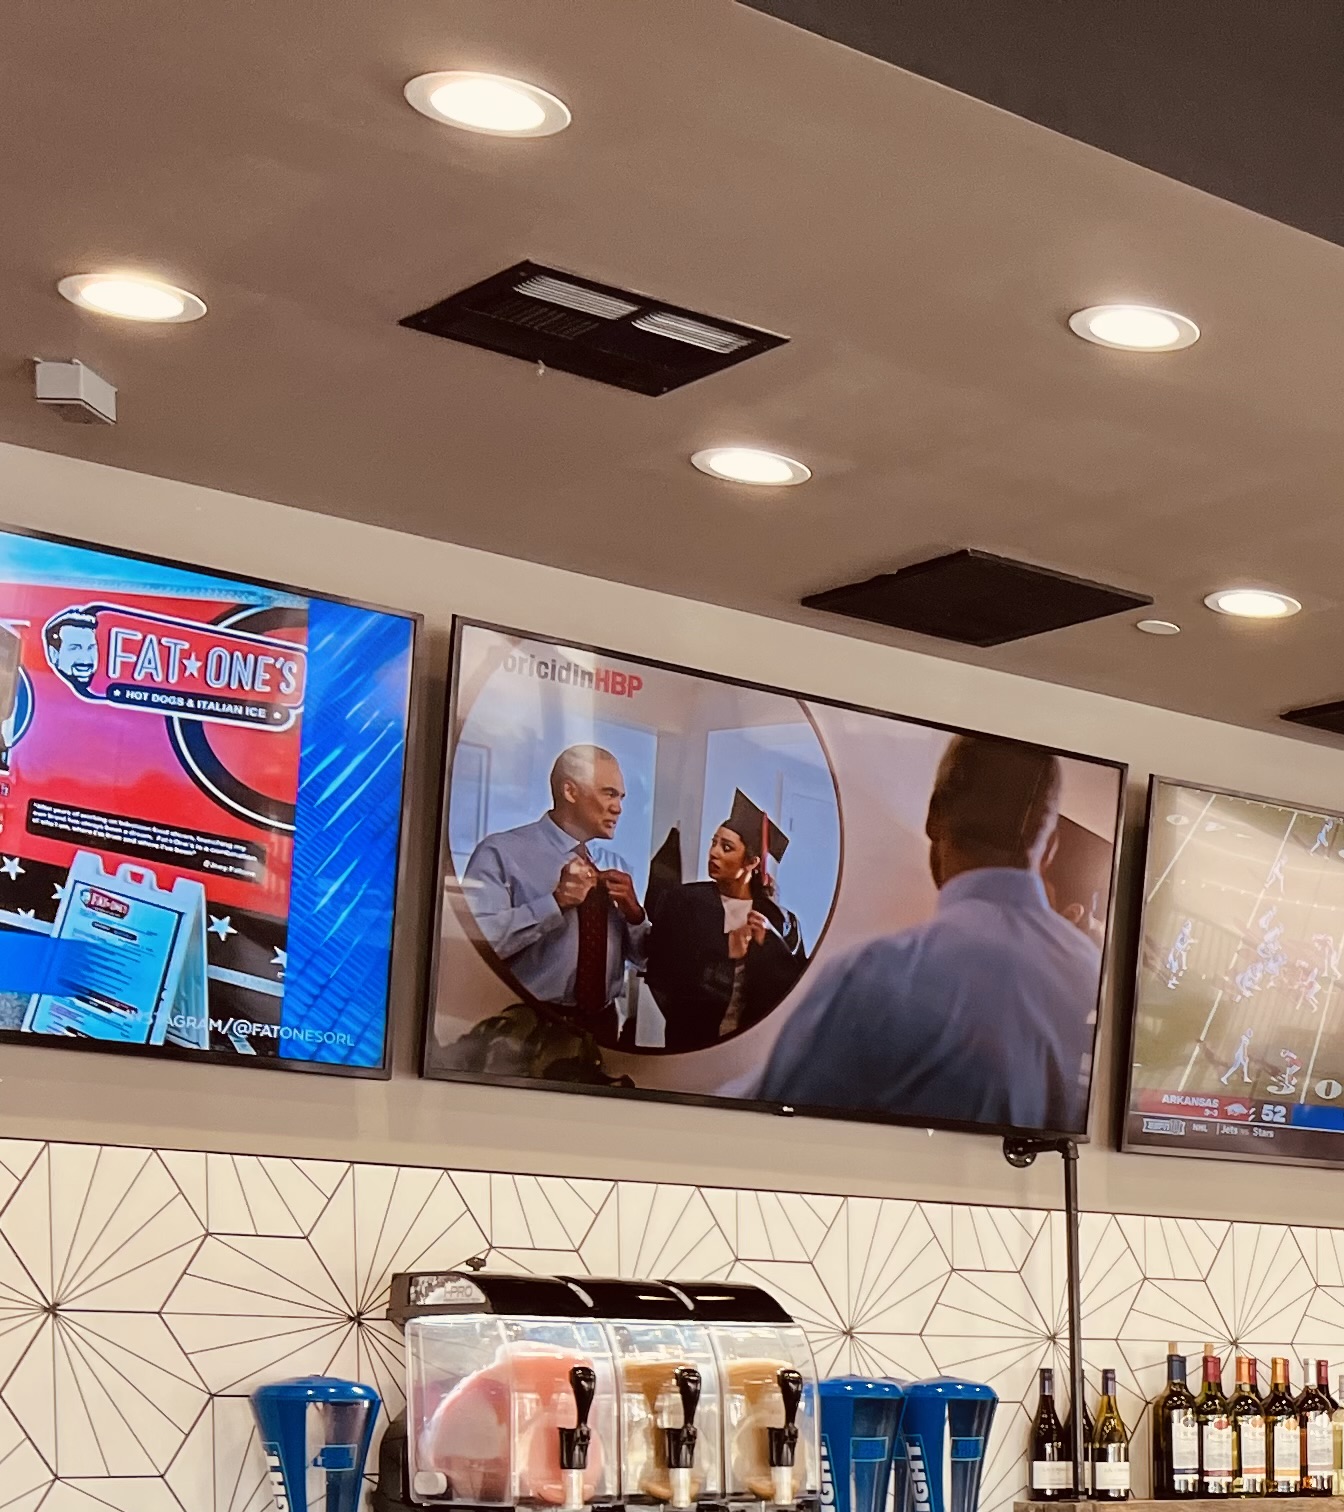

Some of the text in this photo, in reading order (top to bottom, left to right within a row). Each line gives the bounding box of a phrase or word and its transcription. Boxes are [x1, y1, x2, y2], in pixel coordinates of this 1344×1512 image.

[107, 626, 298, 696] FAT ONE'S
[125, 689, 267, 719] HOT DOGS & ITALIAN ICE
[1161, 1094, 1287, 1124] ARKANSAS 52
[1220, 1124, 1239, 1135] Jets
[1252, 1126, 1275, 1139] Stars
